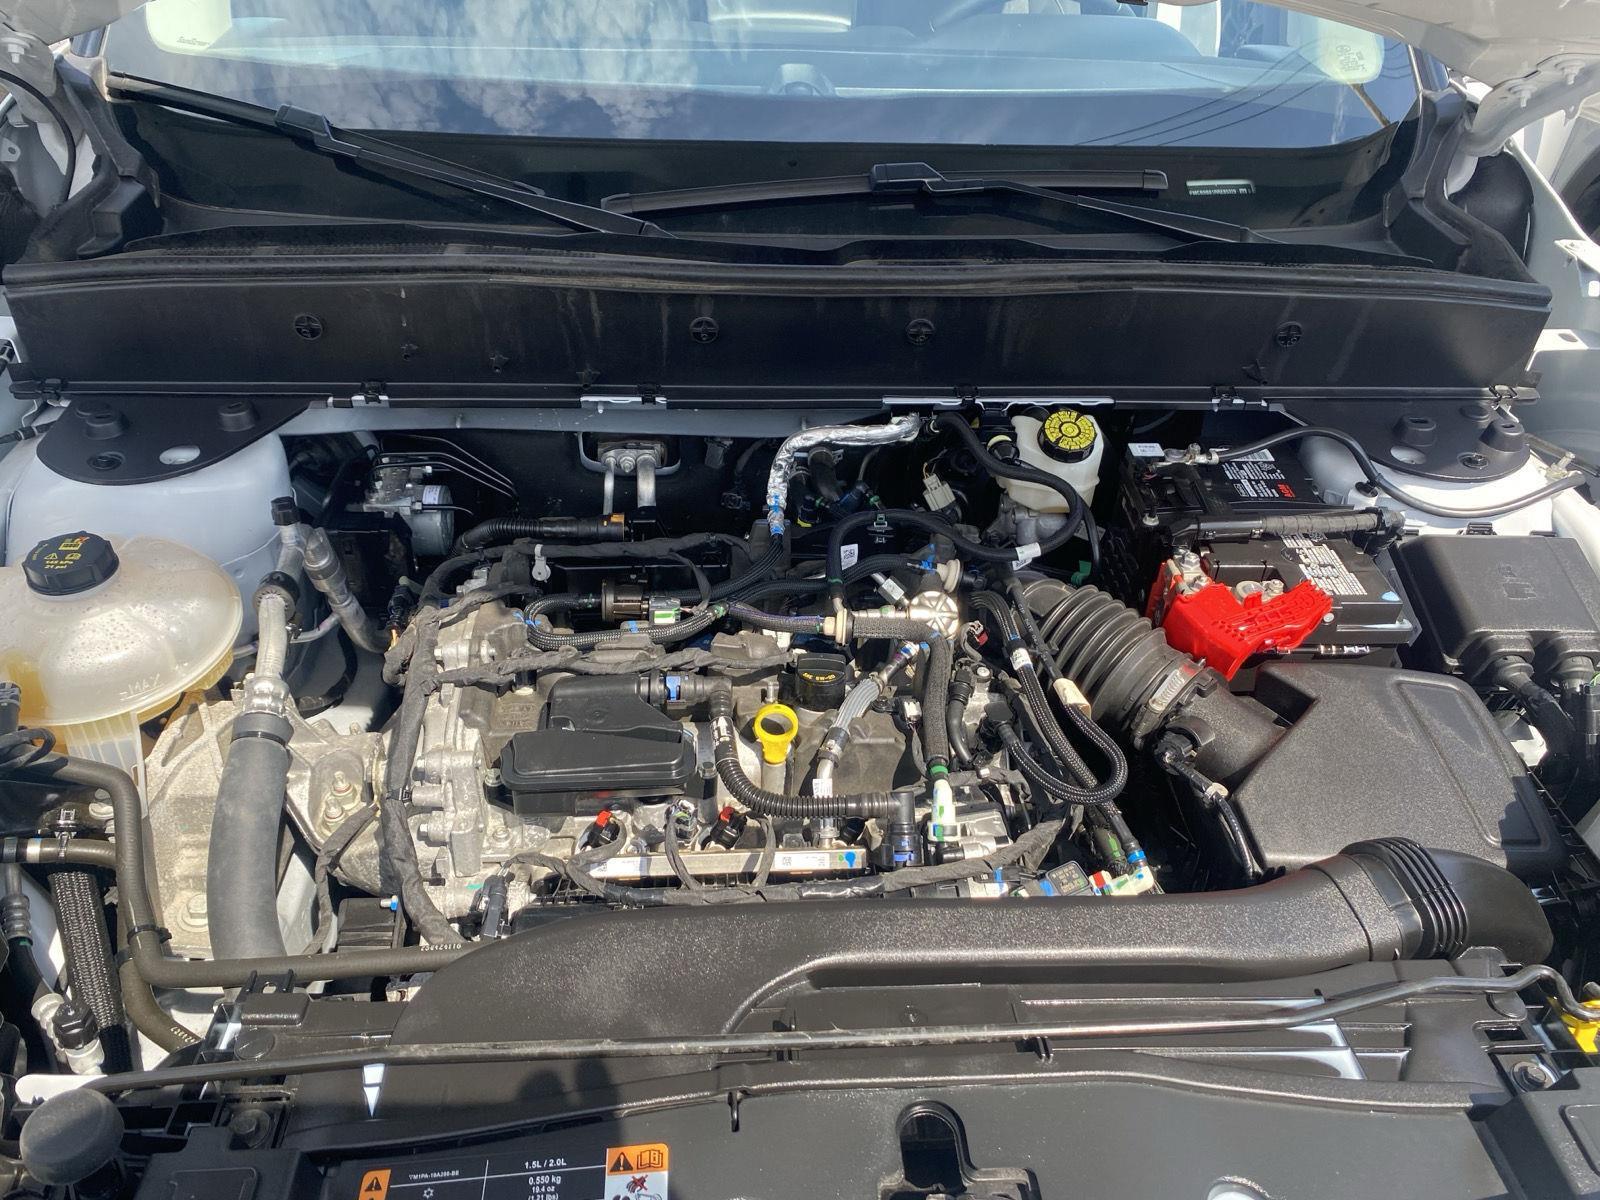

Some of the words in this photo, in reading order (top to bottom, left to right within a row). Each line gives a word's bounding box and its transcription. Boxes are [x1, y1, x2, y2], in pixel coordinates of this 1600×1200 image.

[525, 1160, 542, 1169] 1.5L
[548, 1157, 567, 1167] 2.0L
[528, 1175, 550, 1185] 0.550
[551, 1174, 562, 1185] kg
